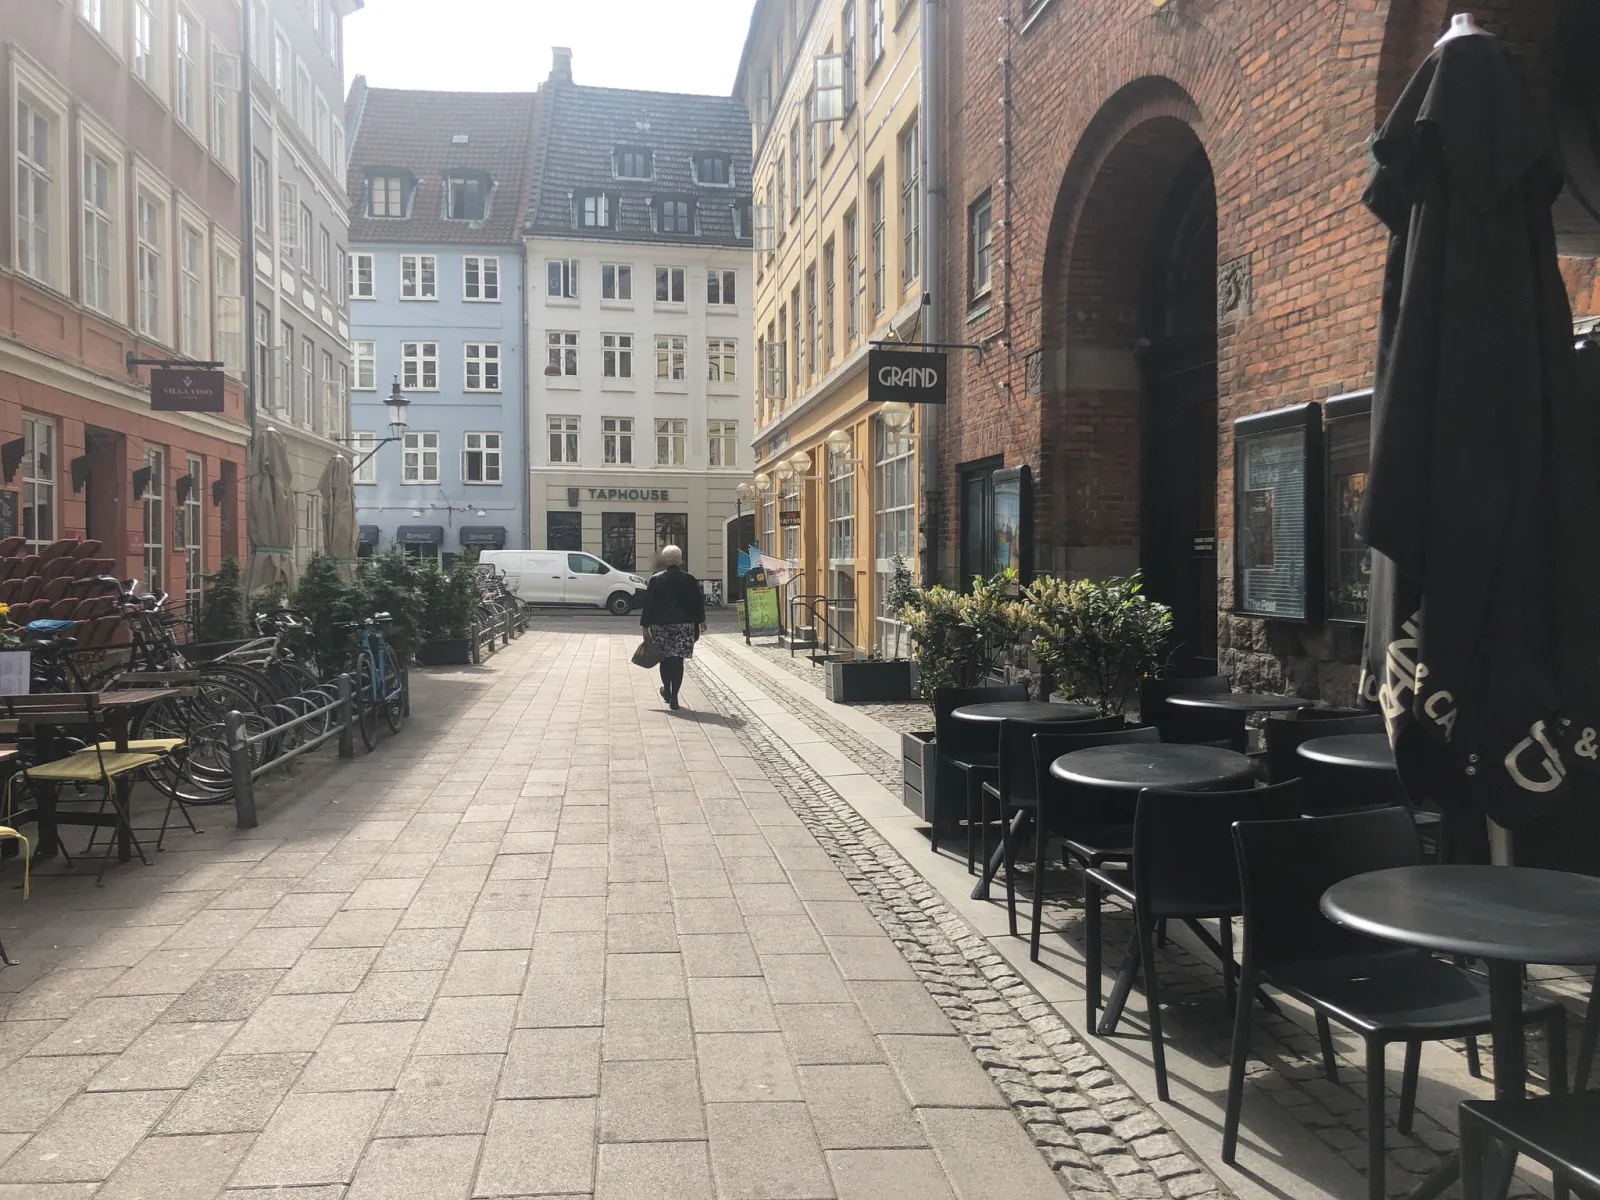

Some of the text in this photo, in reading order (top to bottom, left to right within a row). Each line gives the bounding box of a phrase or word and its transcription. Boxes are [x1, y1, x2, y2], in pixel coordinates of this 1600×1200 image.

[877, 366, 938, 388] GRAND
[163, 387, 188, 395] VILLA
[588, 488, 669, 501] TAPHOUSE
[780, 517, 800, 525] TATTOO
[1248, 598, 1277, 611] The Post
